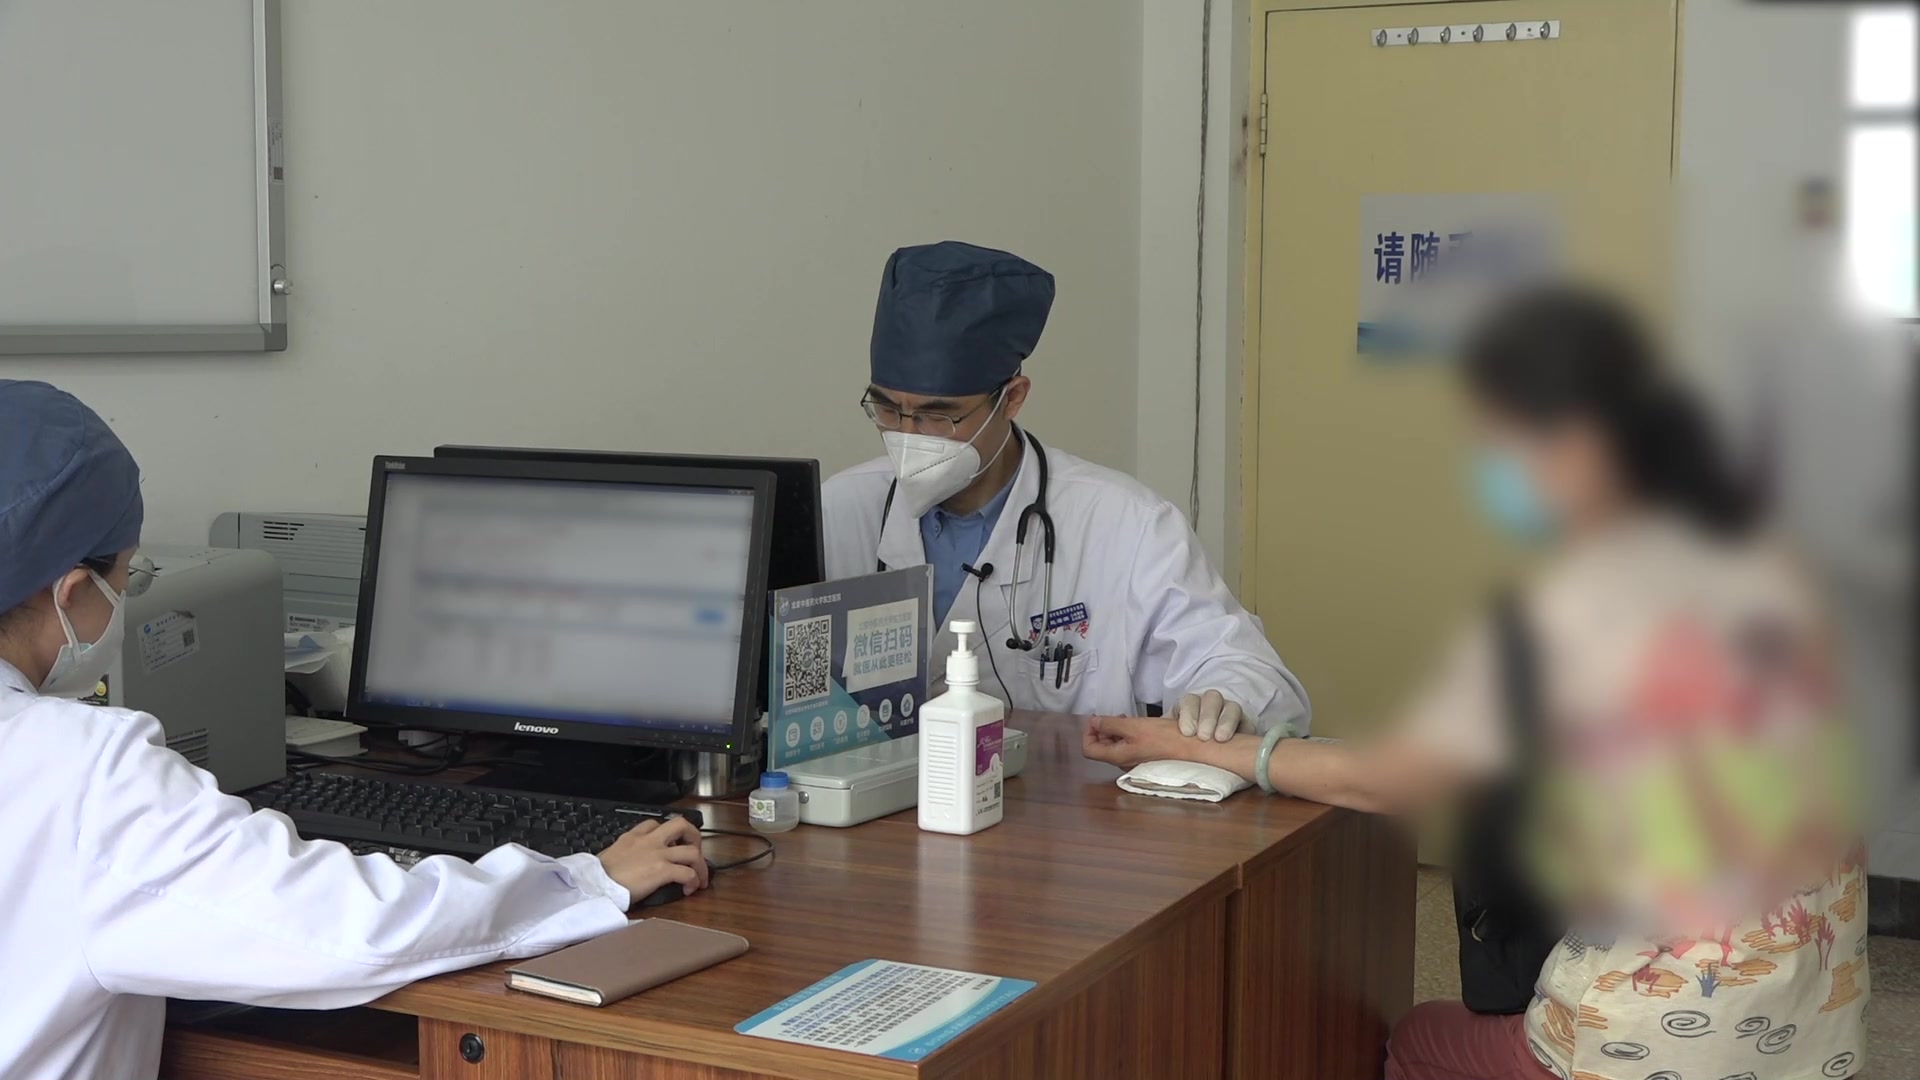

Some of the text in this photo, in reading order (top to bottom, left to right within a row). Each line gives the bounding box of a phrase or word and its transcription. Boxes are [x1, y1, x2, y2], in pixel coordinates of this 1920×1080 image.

[1374, 231, 1474, 285] 请随
[854, 624, 913, 659] 微信扫码
[853, 651, 913, 676] 就医从此更轻松
[514, 721, 559, 734] lenovo
